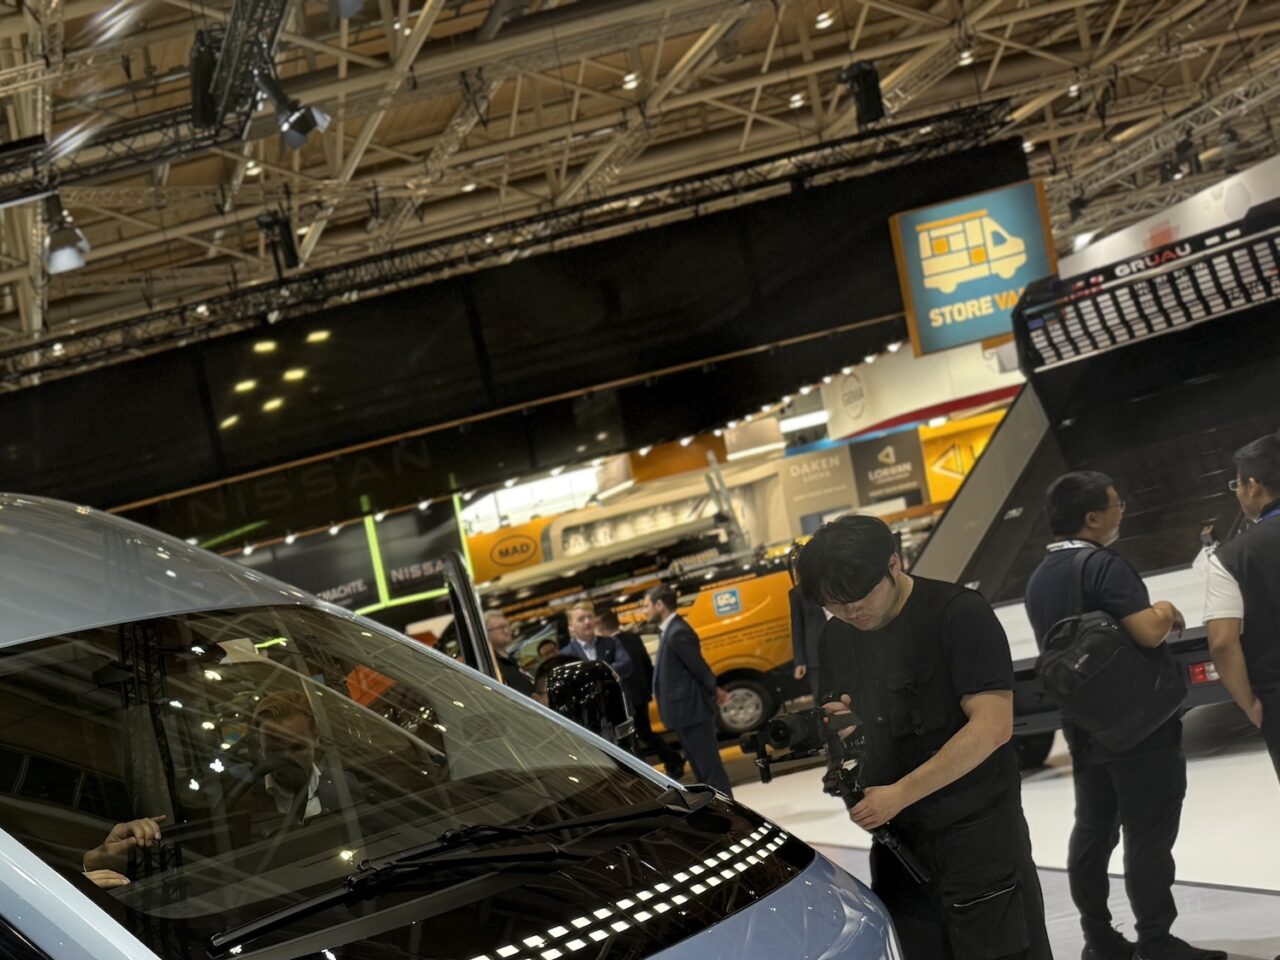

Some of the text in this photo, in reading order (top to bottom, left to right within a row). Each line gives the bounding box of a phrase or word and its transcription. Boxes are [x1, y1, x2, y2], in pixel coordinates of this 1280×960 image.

[1115, 243, 1191, 277] GRUAU
[929, 295, 994, 327] STORE
[498, 543, 530, 559] MAD
[390, 559, 445, 583] NISSA
